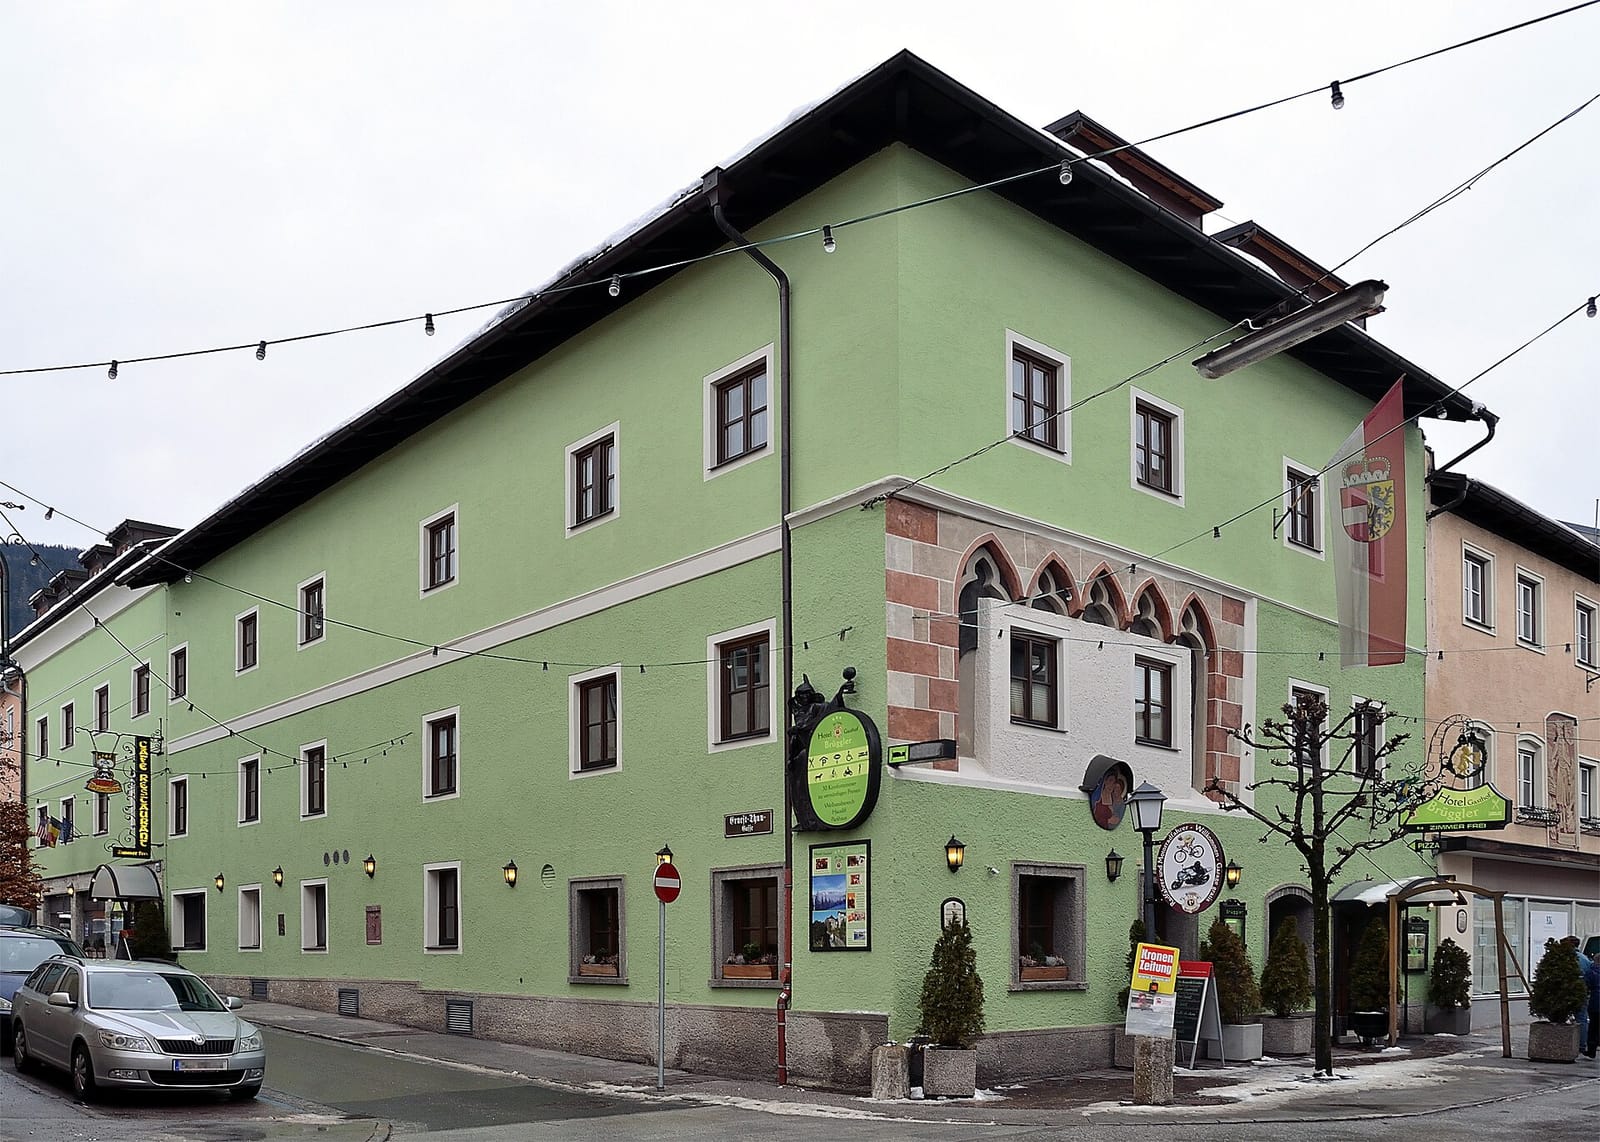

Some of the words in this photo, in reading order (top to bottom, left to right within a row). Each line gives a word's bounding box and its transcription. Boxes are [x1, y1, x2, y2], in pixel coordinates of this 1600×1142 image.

[818, 731, 832, 739] Hotel
[1438, 792, 1466, 806] Hotel
[1467, 791, 1492, 806] Gasthof
[1427, 801, 1479, 820] Brüggler
[1195, 824, 1220, 859] Willkommen
[1141, 948, 1174, 963] Kronen
[1139, 960, 1172, 975] Zeitung
